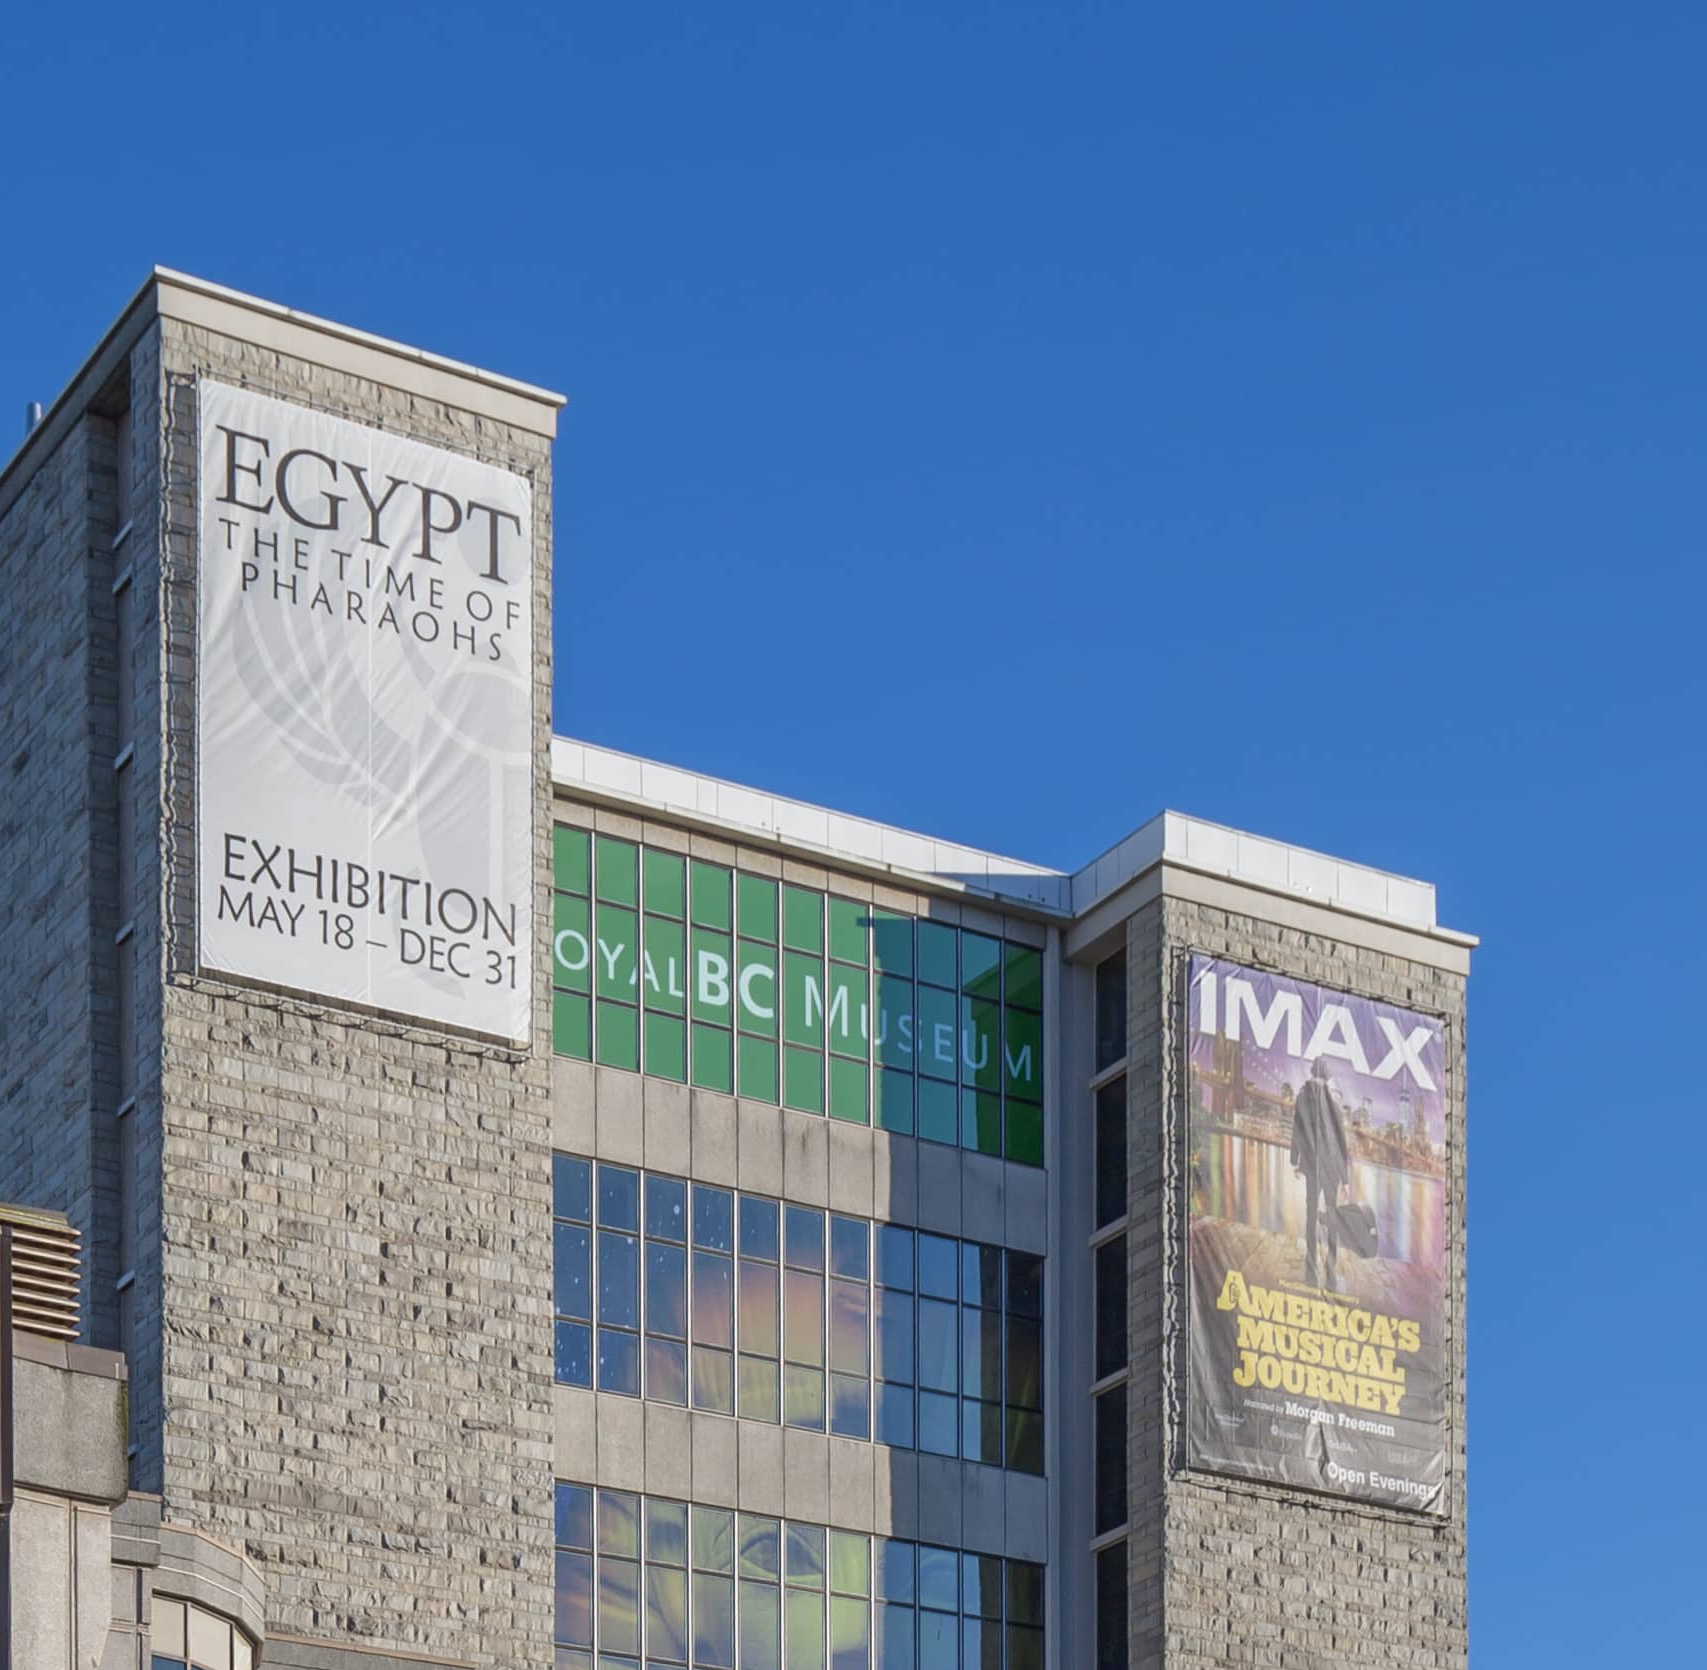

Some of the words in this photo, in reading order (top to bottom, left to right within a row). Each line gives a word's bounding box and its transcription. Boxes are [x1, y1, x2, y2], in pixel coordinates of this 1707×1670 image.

[216, 425, 521, 584] EGYPT
[218, 519, 310, 571] THE
[332, 549, 444, 610] TIME
[467, 590, 521, 630] OF
[242, 562, 502, 661] PHARAOHS
[224, 834, 516, 946] EXHIBITION
[218, 885, 306, 938] MAY
[319, 909, 354, 950] 18
[401, 928, 471, 979] DEC
[485, 949, 517, 989] 31
[554, 929, 684, 998] OYAL
[1200, 971, 1437, 1092] IMAX
[1217, 1270, 1420, 1352] AMERICA'S
[1237, 1315, 1405, 1383] MUSICAL
[1233, 1350, 1405, 1415] JOURNEY
[1285, 1401, 1334, 1424] Morgan
[1338, 1413, 1395, 1437] Freeman
[1328, 1461, 1365, 1485] Open
[1370, 1472, 1436, 1499] Evenings
